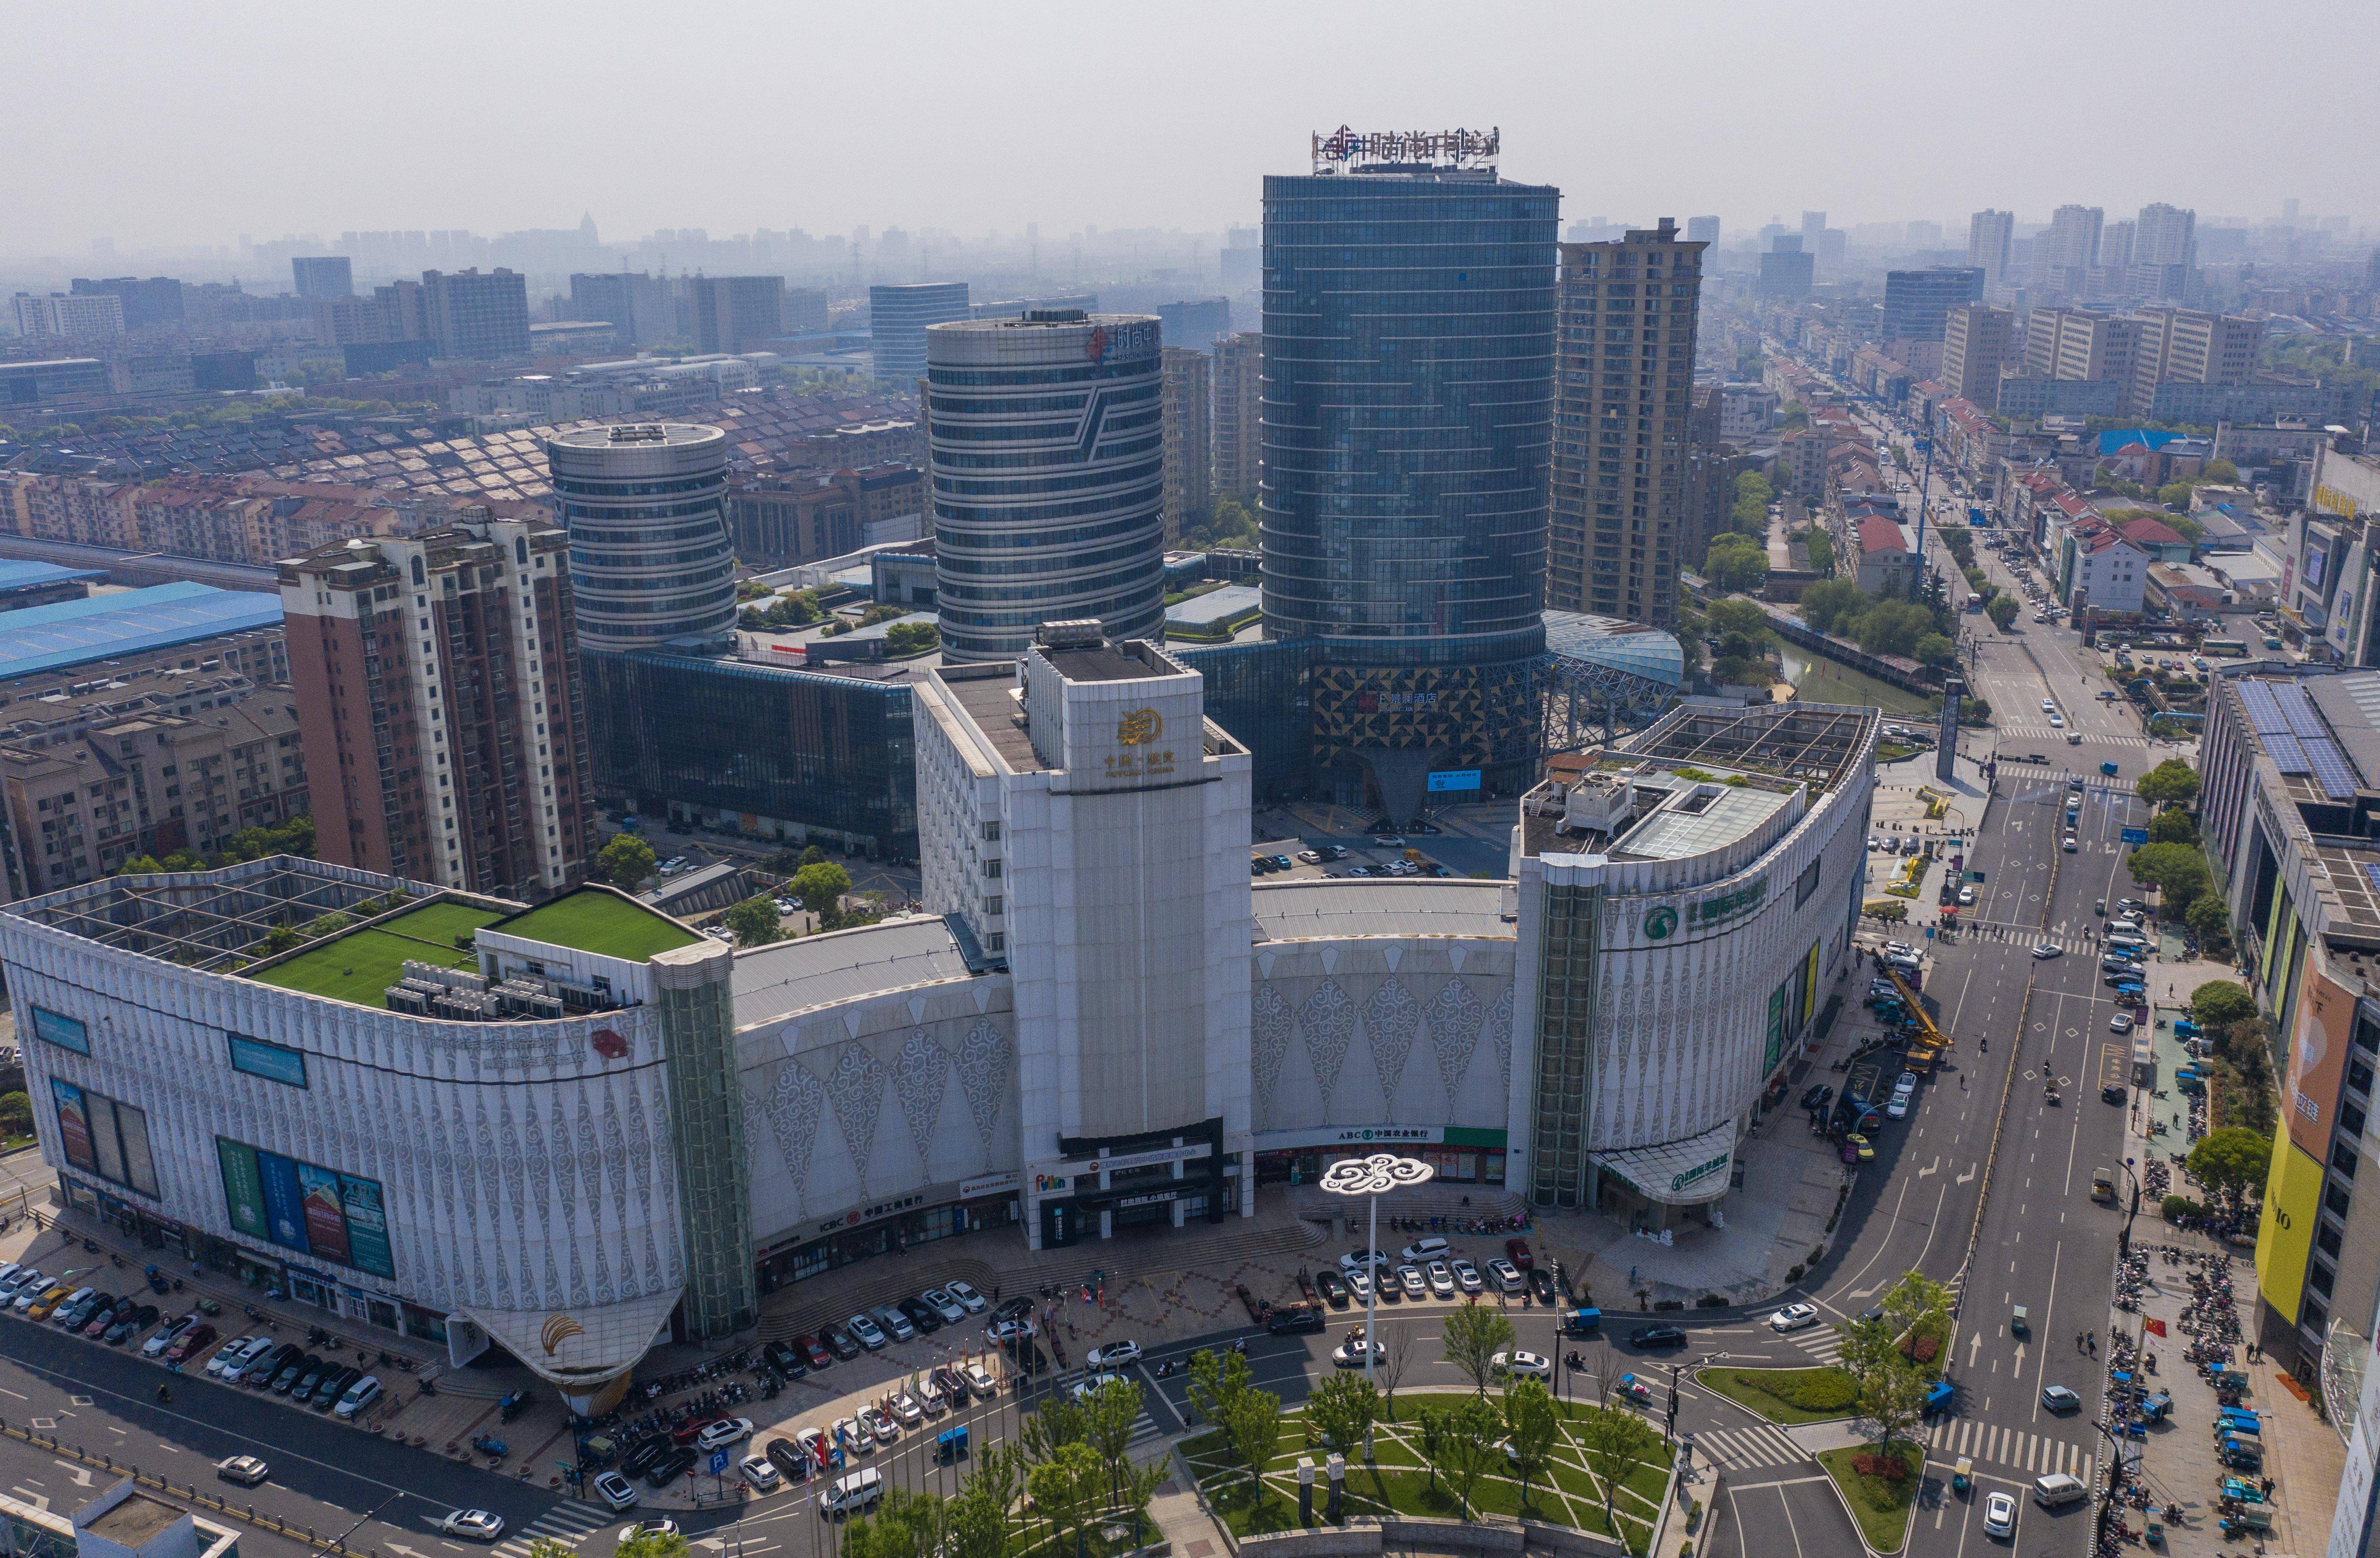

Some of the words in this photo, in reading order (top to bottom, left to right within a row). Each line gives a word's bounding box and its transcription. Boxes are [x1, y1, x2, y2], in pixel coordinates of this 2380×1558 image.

[1118, 324, 1160, 349] 时尚中心
[1118, 350, 1144, 362] FASHION
[1375, 1129, 1428, 1138] 中国农业银行
[820, 1217, 844, 1232] ICBC
[713, 1454, 722, 1468] P
